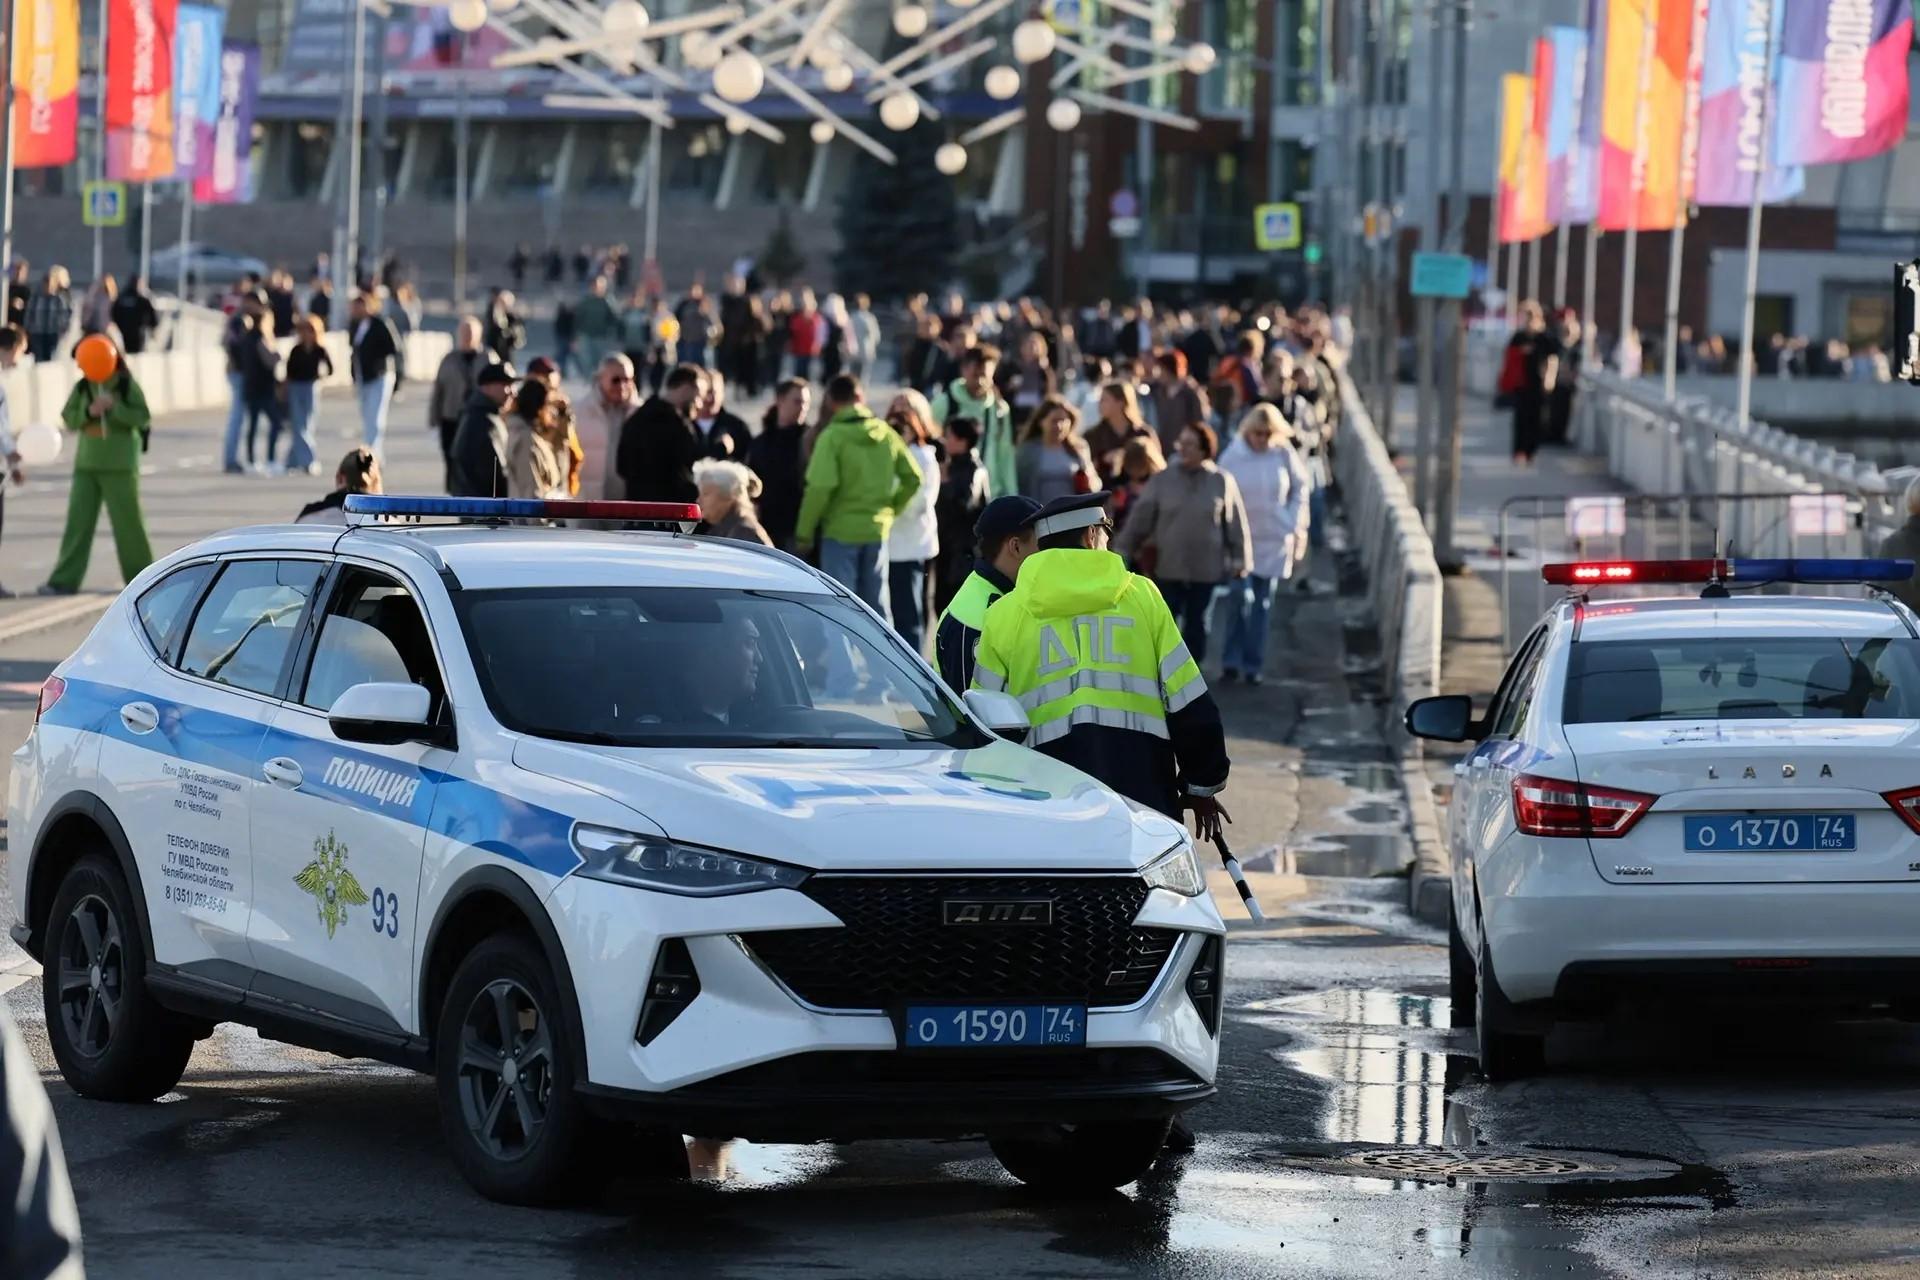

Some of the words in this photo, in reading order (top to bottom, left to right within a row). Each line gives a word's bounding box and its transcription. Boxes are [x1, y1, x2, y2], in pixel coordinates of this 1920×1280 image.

[1038, 615, 1134, 676] ДПС
[322, 756, 421, 808] ПОЛИЦИЯ
[1708, 764, 1833, 780] LADA
[181, 783, 198, 798] УМВД
[198, 787, 219, 802] России
[174, 799, 182, 809] по
[188, 801, 221, 820] Челябинску
[1730, 819, 1799, 846] 1370
[1818, 818, 1845, 839] 74
[1821, 838, 1842, 847] RUS
[167, 834, 199, 852] ТЕЛЕФОН
[200, 842, 230, 860] ДОВЕРИЯ
[168, 852, 177, 864] ГУ
[179, 854, 195, 869] МВД
[196, 858, 219, 874] России
[220, 866, 229, 877] по
[161, 864, 208, 885] Челябинской
[209, 876, 234, 892] области
[165, 885, 171, 899] 8
[173, 887, 193, 907] (351)
[372, 887, 399, 939] 93
[953, 904, 1043, 922] ДПС
[952, 1009, 1027, 1042] 1590
[1046, 1008, 1075, 1034] 74
[1049, 1032, 1071, 1043] RUS
